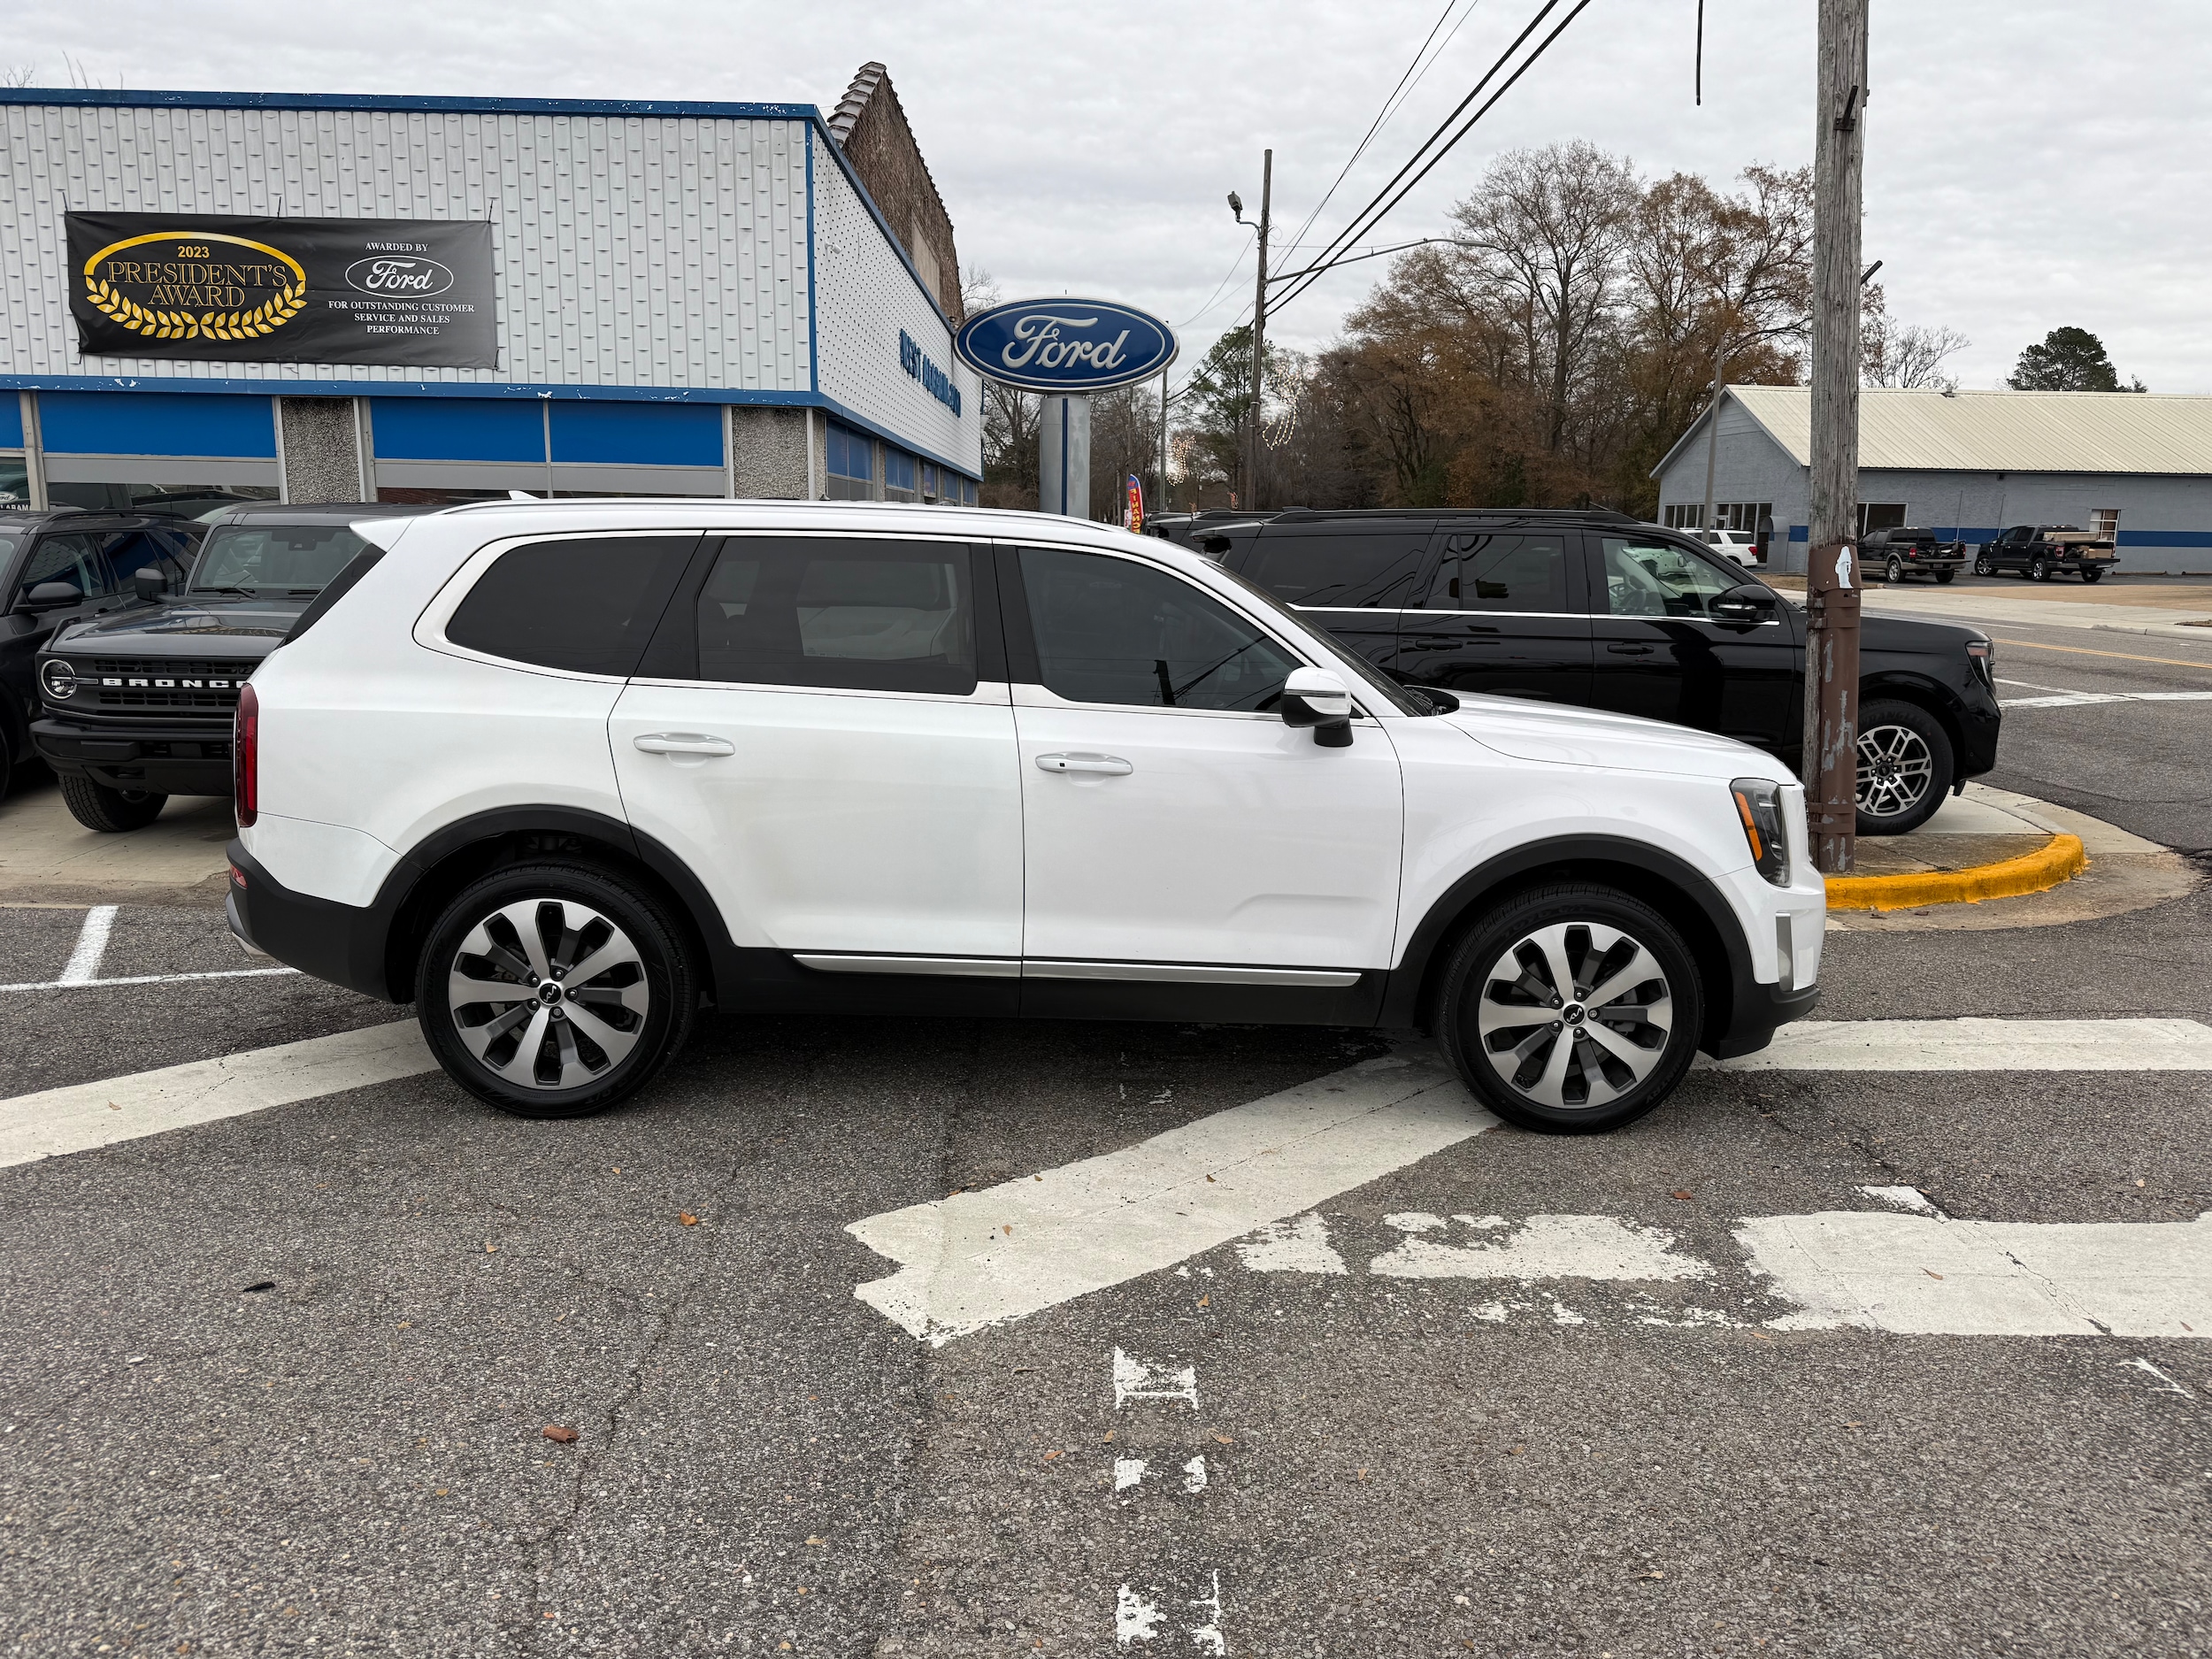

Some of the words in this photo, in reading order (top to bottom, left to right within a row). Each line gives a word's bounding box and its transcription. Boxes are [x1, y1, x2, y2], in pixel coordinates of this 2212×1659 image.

[177, 246, 210, 258] 2023
[365, 242, 412, 252] AWARDED
[415, 243, 428, 252] BY
[107, 261, 287, 287] PRESIDENT'S
[365, 259, 433, 290] Ford
[147, 285, 245, 308] AWARD
[328, 300, 348, 310] FOR
[350, 301, 419, 311] OUTSTANDING
[421, 303, 474, 312] CUSTOMER
[354, 313, 396, 323] SERVICE
[398, 314, 418, 323] AND
[420, 315, 450, 324] SALES
[366, 325, 440, 334] PERFORMANCE
[1001, 314, 1131, 370] Ford
